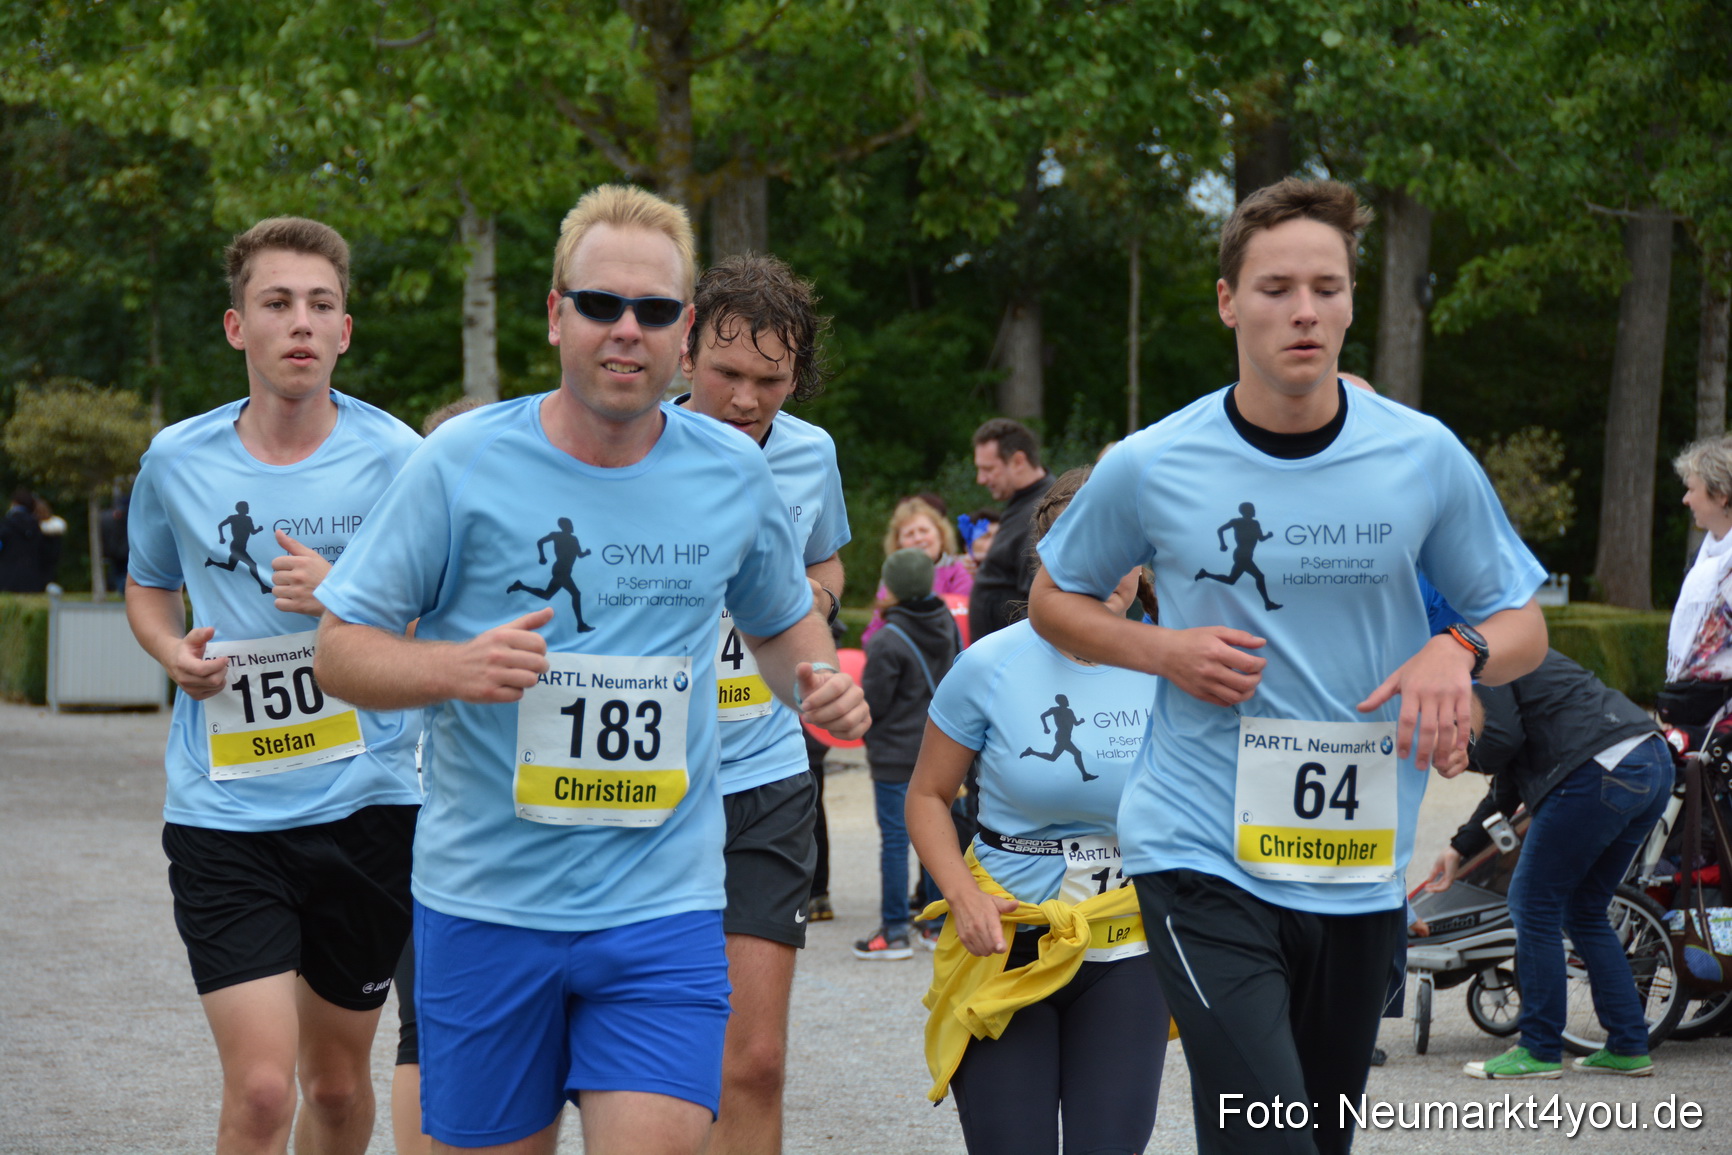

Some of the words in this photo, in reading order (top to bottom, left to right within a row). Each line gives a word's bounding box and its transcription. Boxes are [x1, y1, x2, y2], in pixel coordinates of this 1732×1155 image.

[789, 505, 803, 523] IP
[272, 517, 324, 536] GYM
[331, 515, 363, 534] HIP
[1284, 524, 1346, 546] GYM
[1356, 523, 1393, 545] HIP
[601, 543, 664, 566] GYM
[674, 543, 710, 565] HIP
[1301, 556, 1375, 569] P-Seminar
[617, 576, 693, 590] P-Seminar
[1283, 572, 1389, 585] Halbmarathon
[597, 592, 705, 608] Halbmarathon
[721, 625, 744, 670] 4
[536, 670, 587, 687] ARTL
[591, 673, 668, 690] Neumarkt
[231, 666, 324, 723] 150
[718, 685, 751, 704] hias
[1093, 709, 1141, 729] GYM
[560, 697, 662, 762] 183
[252, 732, 316, 757] Stefan
[1244, 733, 1303, 752] PARTL
[1307, 738, 1376, 754] Neumarkt
[554, 775, 657, 803] Christian
[1293, 761, 1359, 821] 64
[1000, 834, 1047, 847] SYNERGY
[1015, 845, 1058, 854] SPORTS
[1259, 833, 1378, 866] Christopher
[1069, 847, 1111, 862] PARTL
[1107, 925, 1131, 944] Lea
